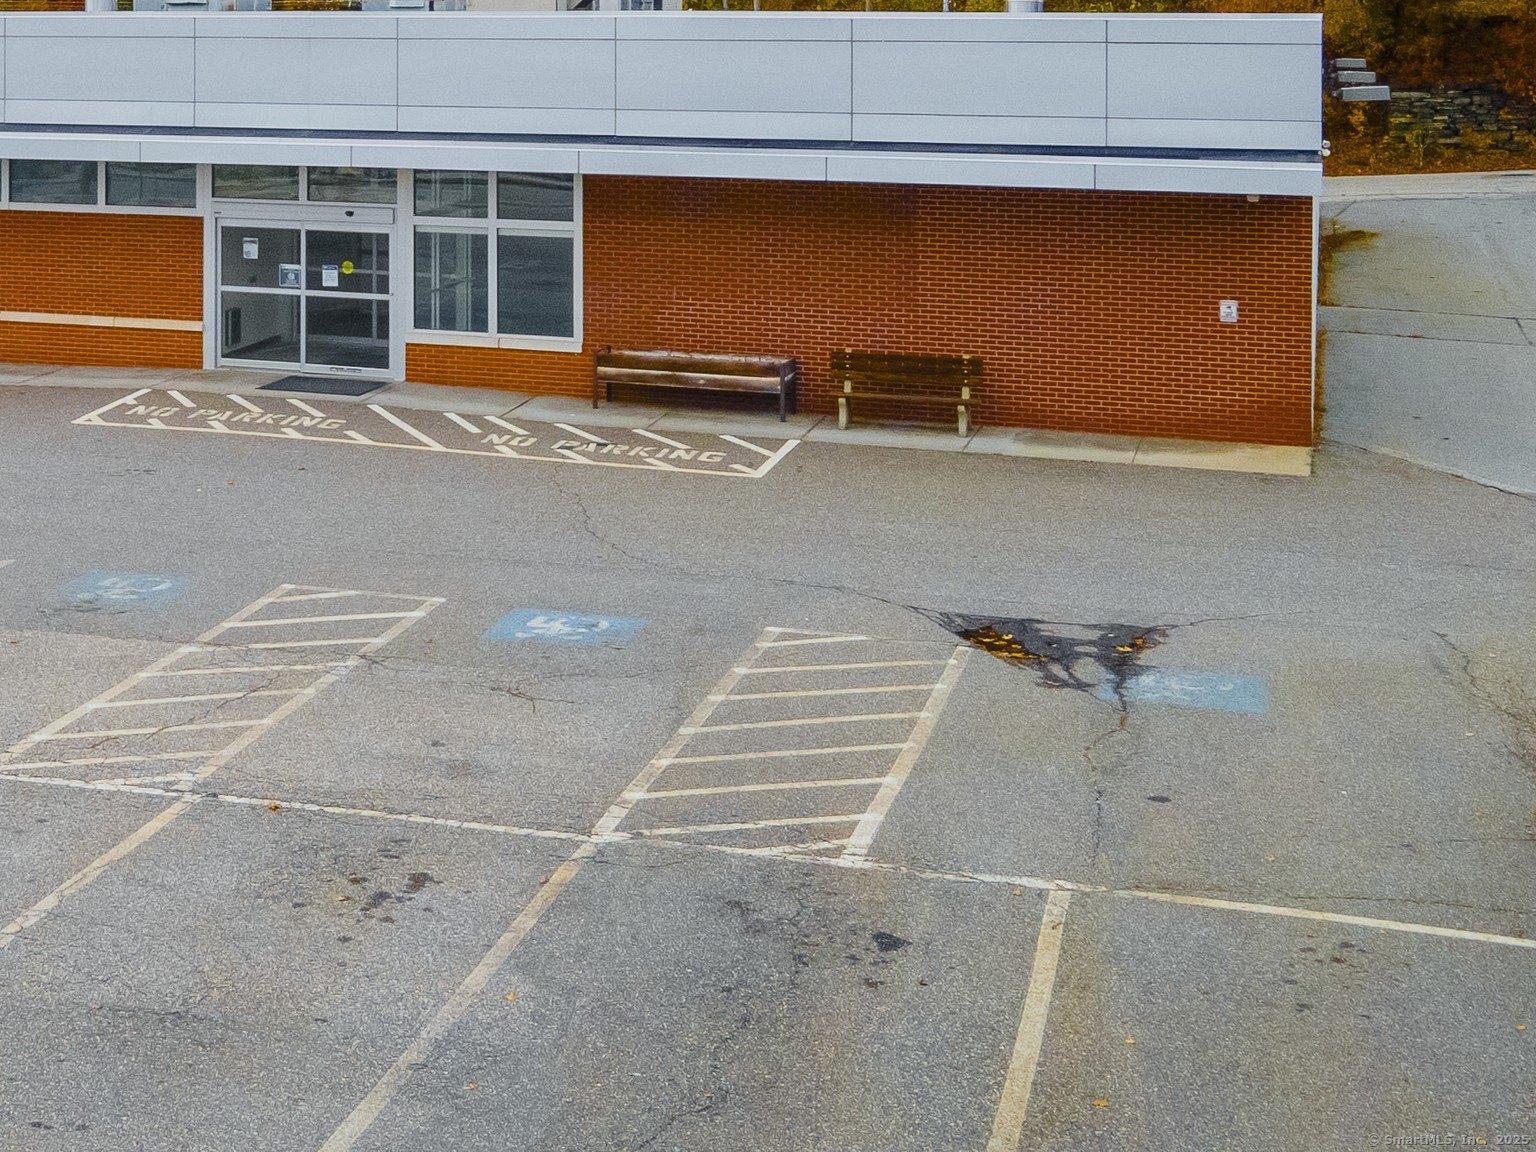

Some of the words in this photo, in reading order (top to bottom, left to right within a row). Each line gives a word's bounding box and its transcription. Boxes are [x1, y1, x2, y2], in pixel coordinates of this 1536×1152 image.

[125, 405, 179, 417] NO
[187, 409, 347, 429] PARKING
[481, 433, 537, 447] NO
[551, 440, 727, 463] PARKING
